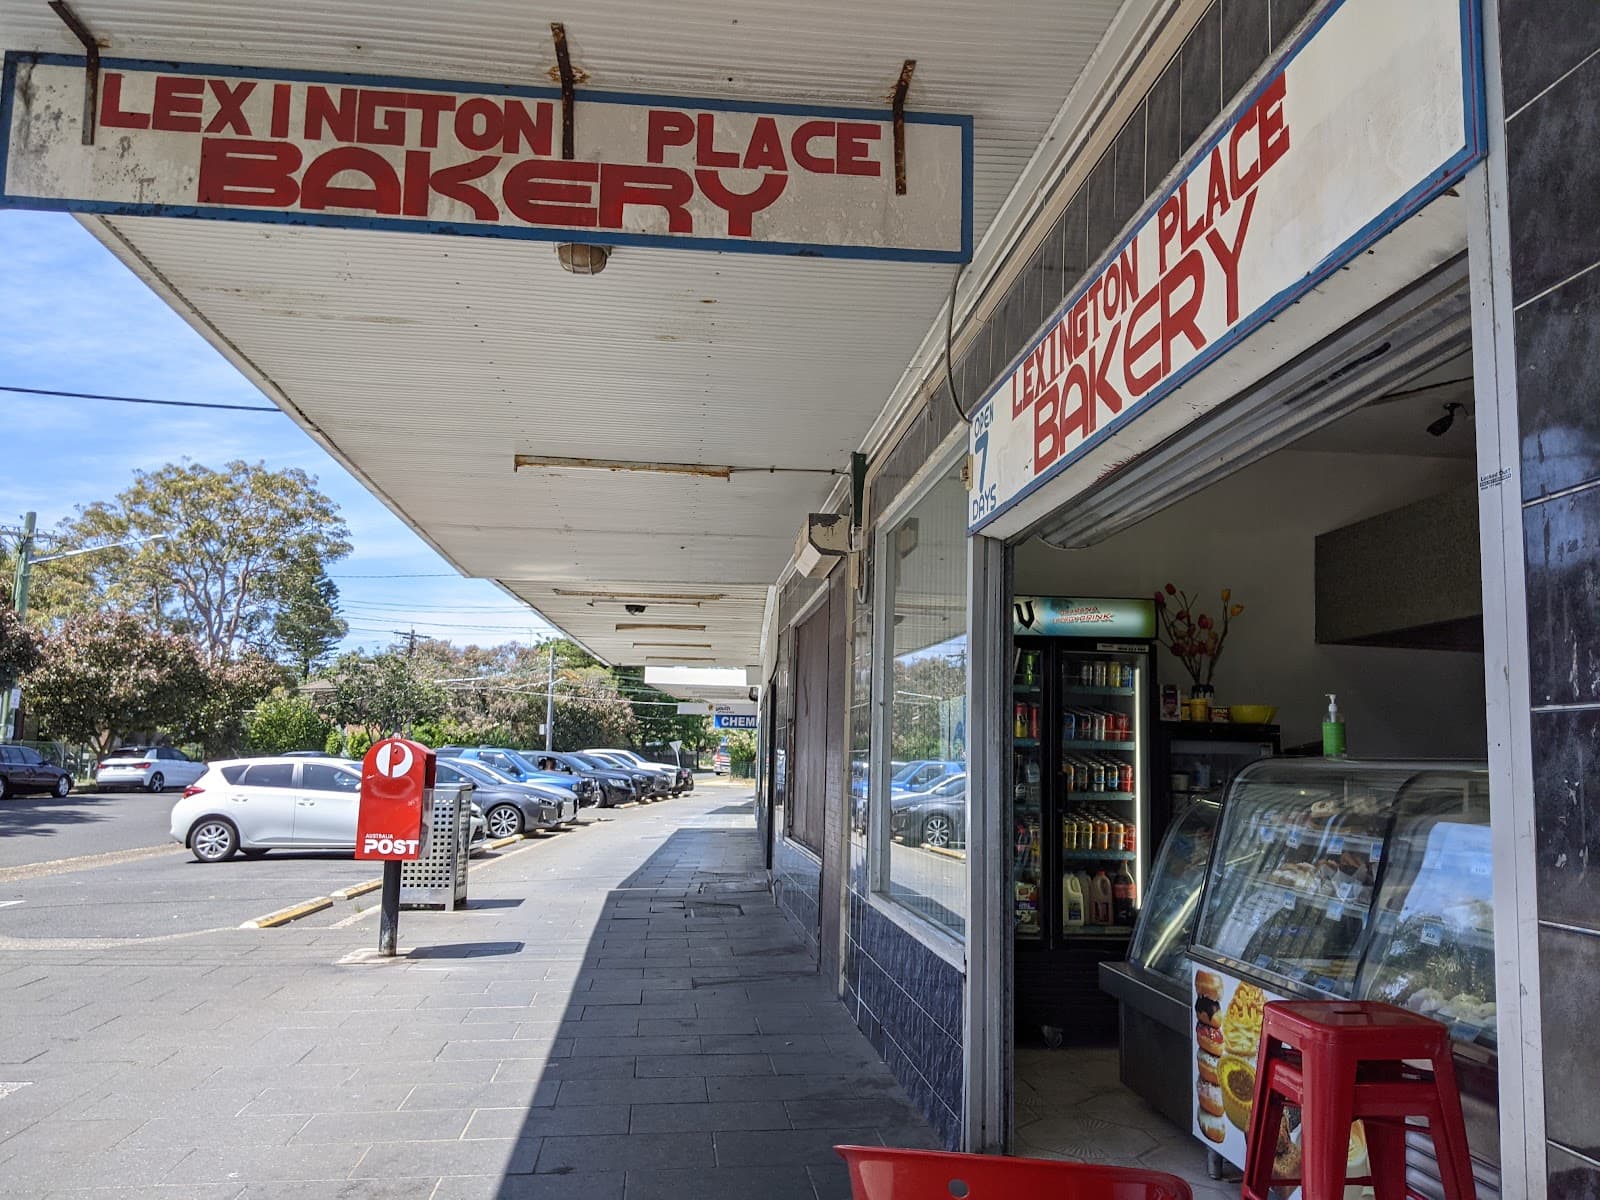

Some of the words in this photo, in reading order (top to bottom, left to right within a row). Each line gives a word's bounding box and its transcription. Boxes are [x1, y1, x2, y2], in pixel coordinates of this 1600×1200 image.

[100, 73, 553, 156] LEXINGTON
[647, 110, 881, 177] PLACE
[197, 136, 788, 237] BAKERY
[1012, 235, 1139, 421] LEXINGTON
[1158, 70, 1290, 277] PLACE
[1034, 186, 1258, 476] BAKERY
[974, 401, 994, 438] OPEN
[973, 483, 997, 521] DAYS
[975, 430, 989, 493] 7
[364, 839, 420, 855] POST
